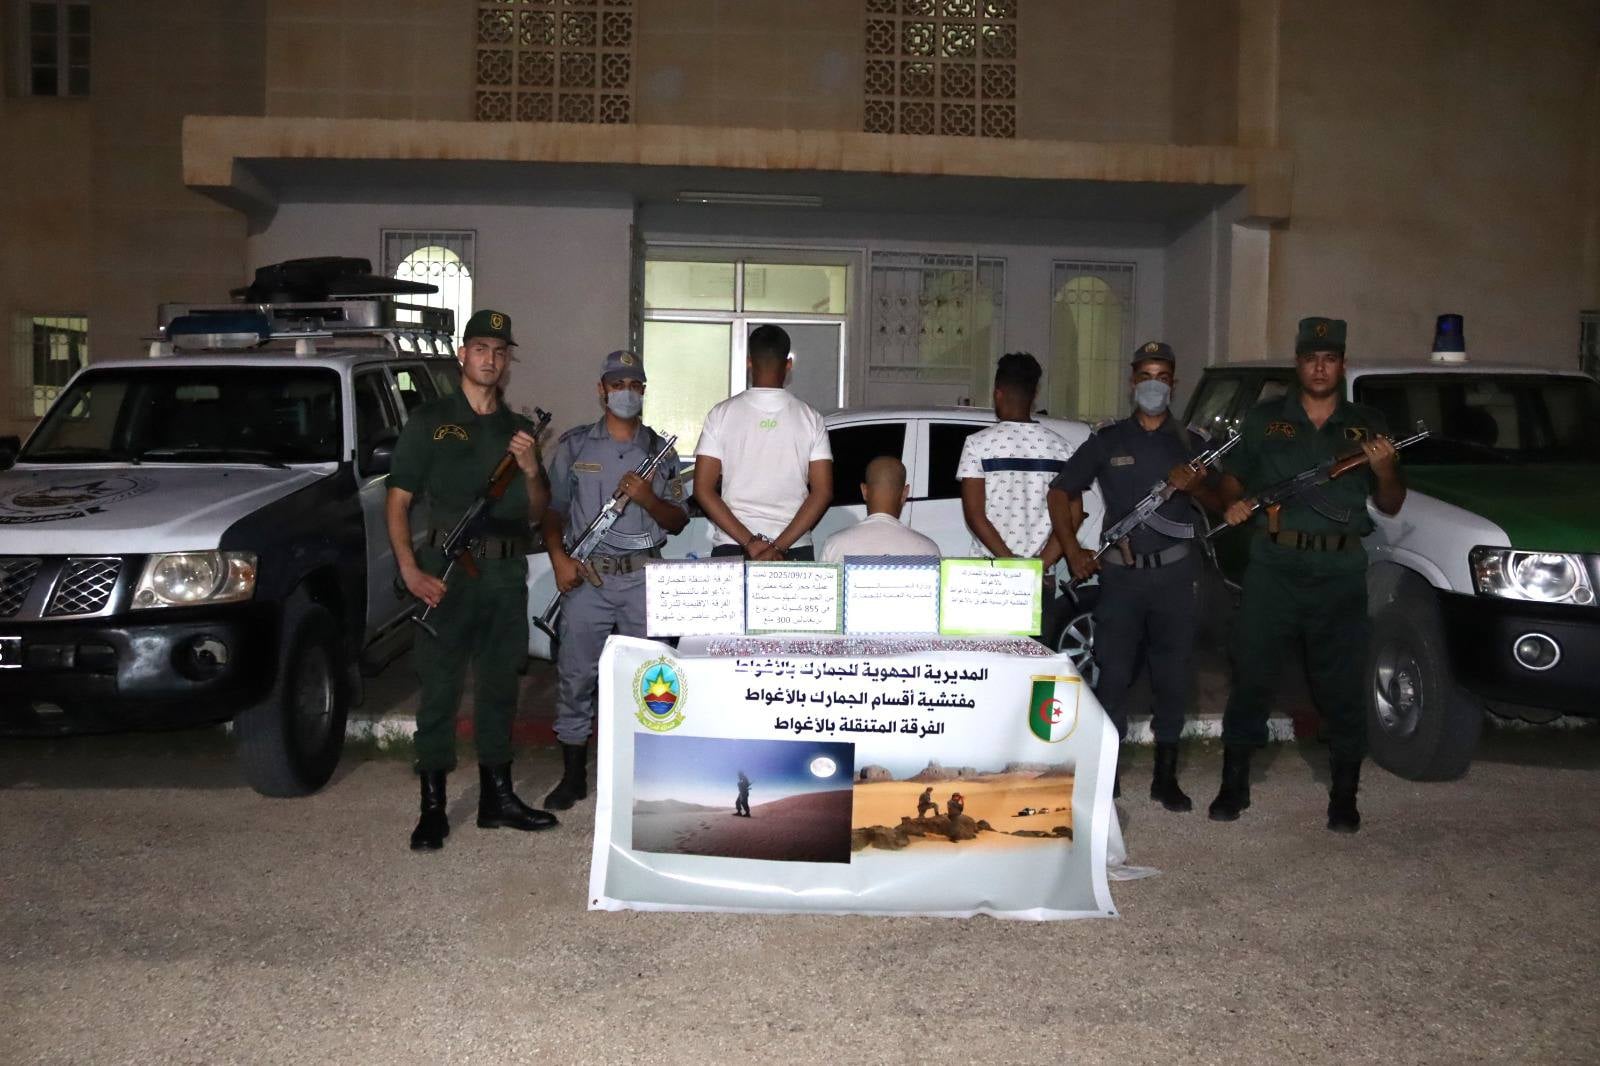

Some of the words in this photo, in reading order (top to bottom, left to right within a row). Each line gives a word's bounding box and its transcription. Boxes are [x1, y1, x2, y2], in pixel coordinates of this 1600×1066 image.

[768, 571, 812, 579] 2025/09/17
[776, 616, 791, 624] 300
[800, 662, 859, 680] للجمارك
[862, 661, 921, 683] الجهوية
[924, 663, 988, 684] المديرية
[745, 687, 807, 708] بالأغواط
[810, 690, 868, 709] الجمارك
[871, 689, 915, 710] أقسام
[917, 692, 976, 712] مفتشية
[774, 716, 836, 737] بالأغواط
[839, 716, 897, 734] المتنقلة
[900, 718, 945, 738] الفرقة
